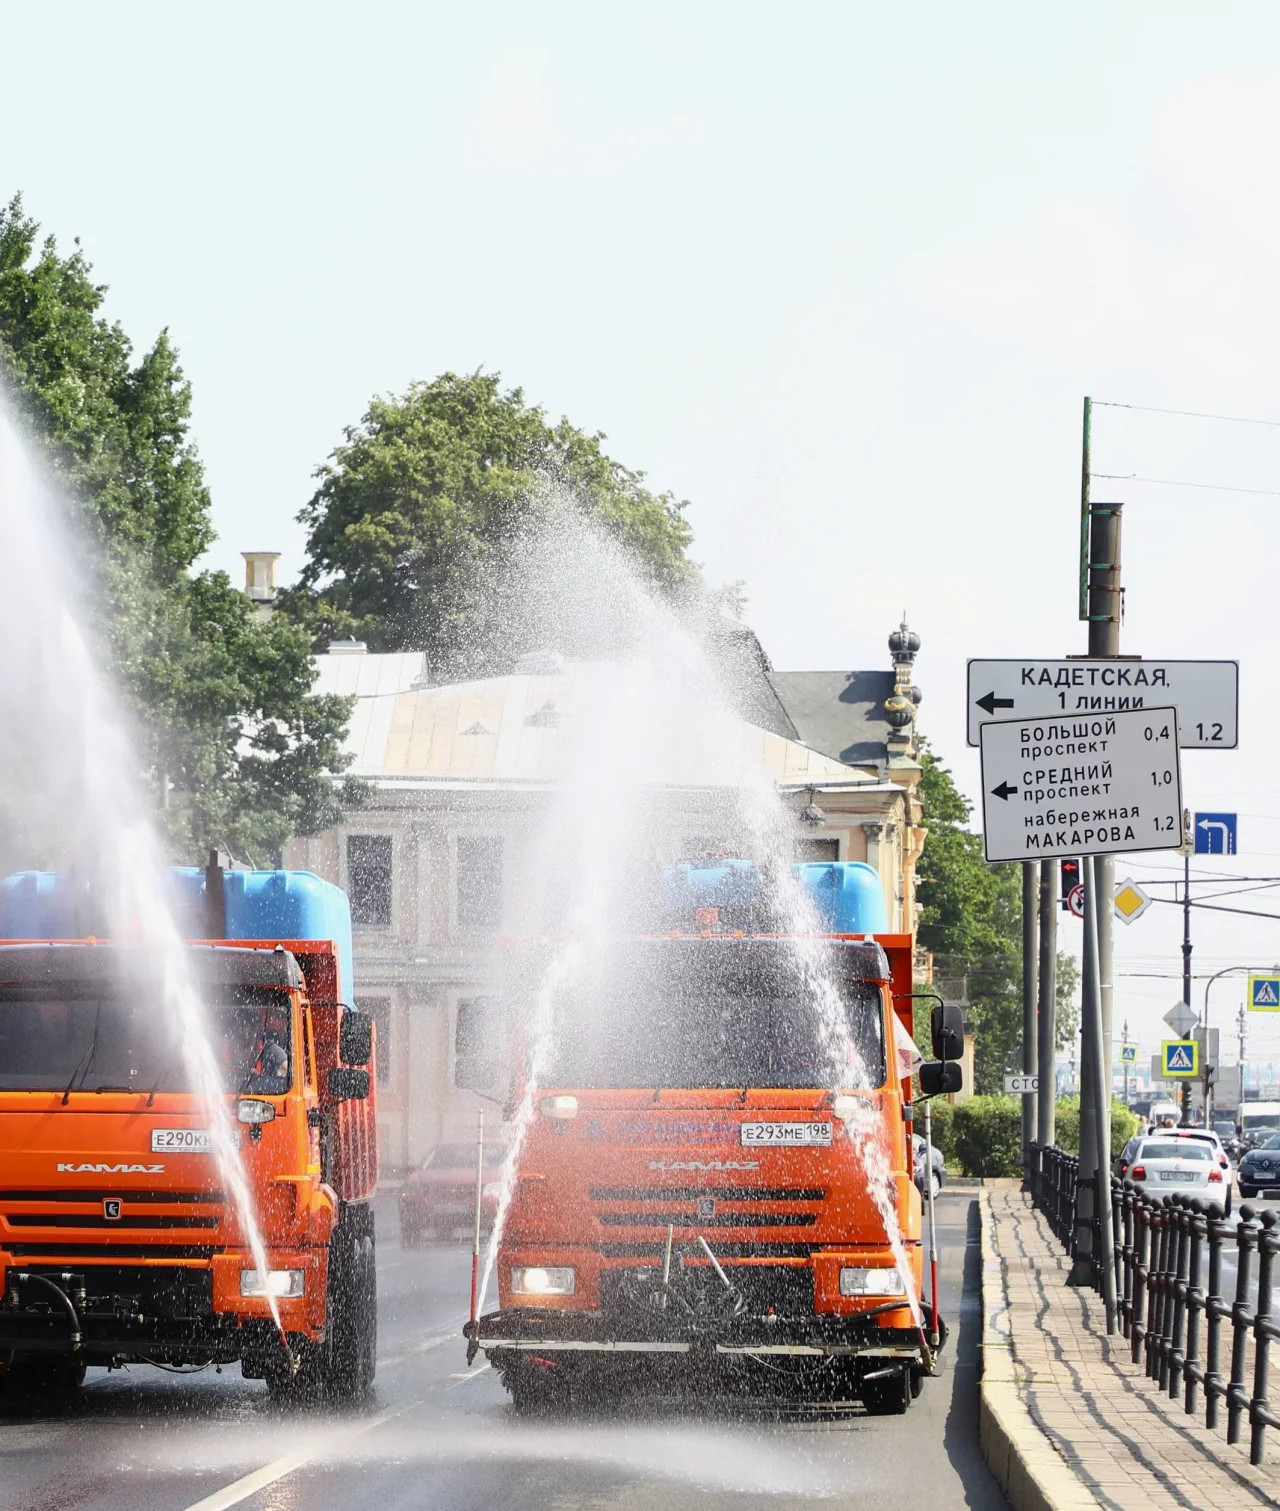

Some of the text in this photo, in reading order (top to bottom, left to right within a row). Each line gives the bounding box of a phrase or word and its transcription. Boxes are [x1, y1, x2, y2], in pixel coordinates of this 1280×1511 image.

[1021, 667, 1170, 688] КАДЕТСКАЯ,
[1058, 691, 1144, 709] 1 линии
[1020, 717, 1116, 742] БОЛЬШОЙ
[1144, 726, 1170, 742] 0,4
[1196, 722, 1223, 742] 1,2
[1021, 740, 1108, 761] проспект
[1023, 760, 1112, 785] СРЕДНИЙ
[1151, 770, 1172, 787] 1,0
[1024, 783, 1111, 804] проспект
[1025, 806, 1139, 827] набережная
[1153, 815, 1174, 832] 1,2
[1026, 826, 1135, 849] МАКАРОВА
[1011, 1078, 1039, 1090] СТО
[57, 1163, 165, 1173] KAMAZ
[649, 1161, 760, 1170] KAMAZ
